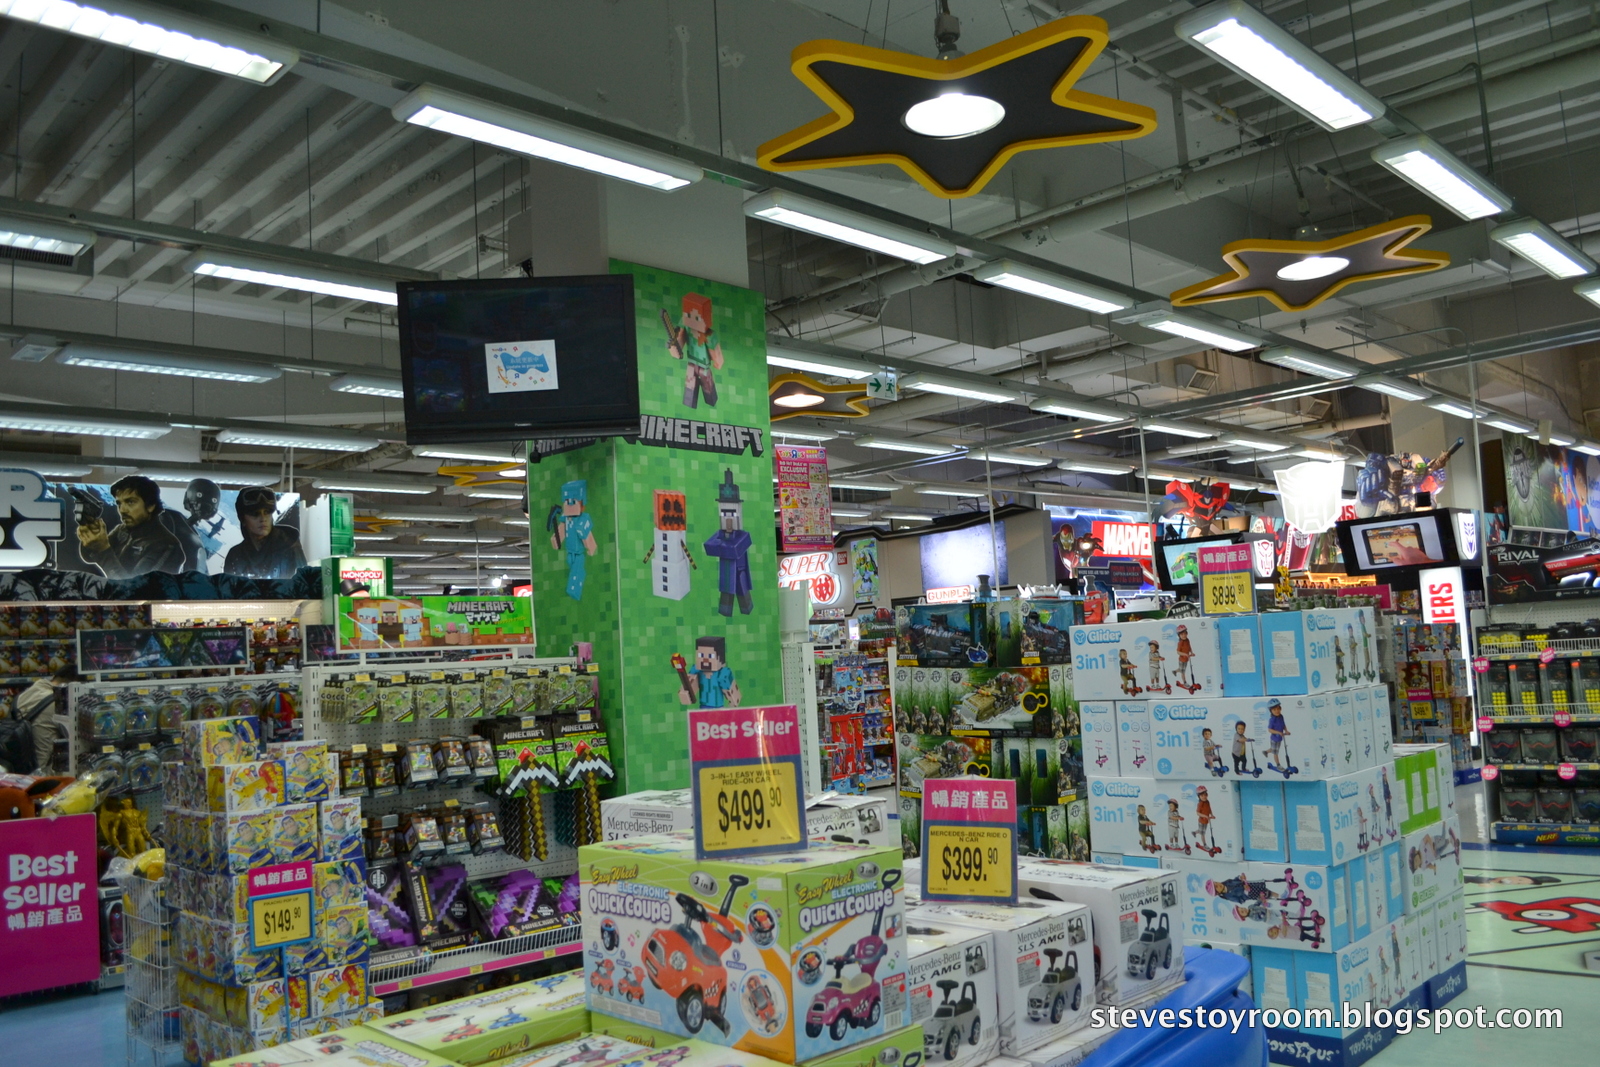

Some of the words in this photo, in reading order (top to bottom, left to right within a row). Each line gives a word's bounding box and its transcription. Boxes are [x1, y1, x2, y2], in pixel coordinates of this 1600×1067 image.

[1498, 549, 1539, 562] RIVAL
[778, 553, 829, 577] SUPER
[343, 571, 382, 579] MONOPOLY
[447, 601, 515, 613] MINECRAFT
[1087, 629, 1122, 645] Glider
[1169, 704, 1208, 720] Glider
[503, 729, 545, 740] MINECRAFT
[561, 722, 599, 733] MINECRAFT
[696, 721, 738, 741] Best
[741, 720, 794, 738] Seller
[710, 772, 733, 780] 3-IN-1
[722, 778, 754, 786] RIDE-ON
[756, 776, 771, 784] CAR
[1105, 782, 1141, 798] Glider
[807, 827, 820, 836] LS
[9, 850, 78, 882] Best
[590, 864, 611, 887] Easy
[611, 863, 639, 881] Wheel
[694, 875, 699, 885] 3
[700, 881, 708, 889] in
[709, 881, 715, 891] 1
[617, 880, 670, 900] ELECTRONIC
[795, 882, 823, 905] Easy
[822, 868, 854, 893] Wheel
[831, 880, 878, 900] ELECTRONIC
[1119, 885, 1159, 903] Mercedes-Benz
[3, 882, 86, 910] Seller
[412, 876, 428, 922] MINECRAFT
[1120, 902, 1134, 912] SLS
[1137, 895, 1159, 907] AMG
[522, 917, 560, 931] MINECRAFT
[1017, 922, 1064, 944] Mercedes-Benz
[1018, 942, 1035, 954] SLS
[1038, 932, 1065, 947] AMG
[368, 950, 415, 965] MINECRAFT
[930, 961, 962, 979] AMG
